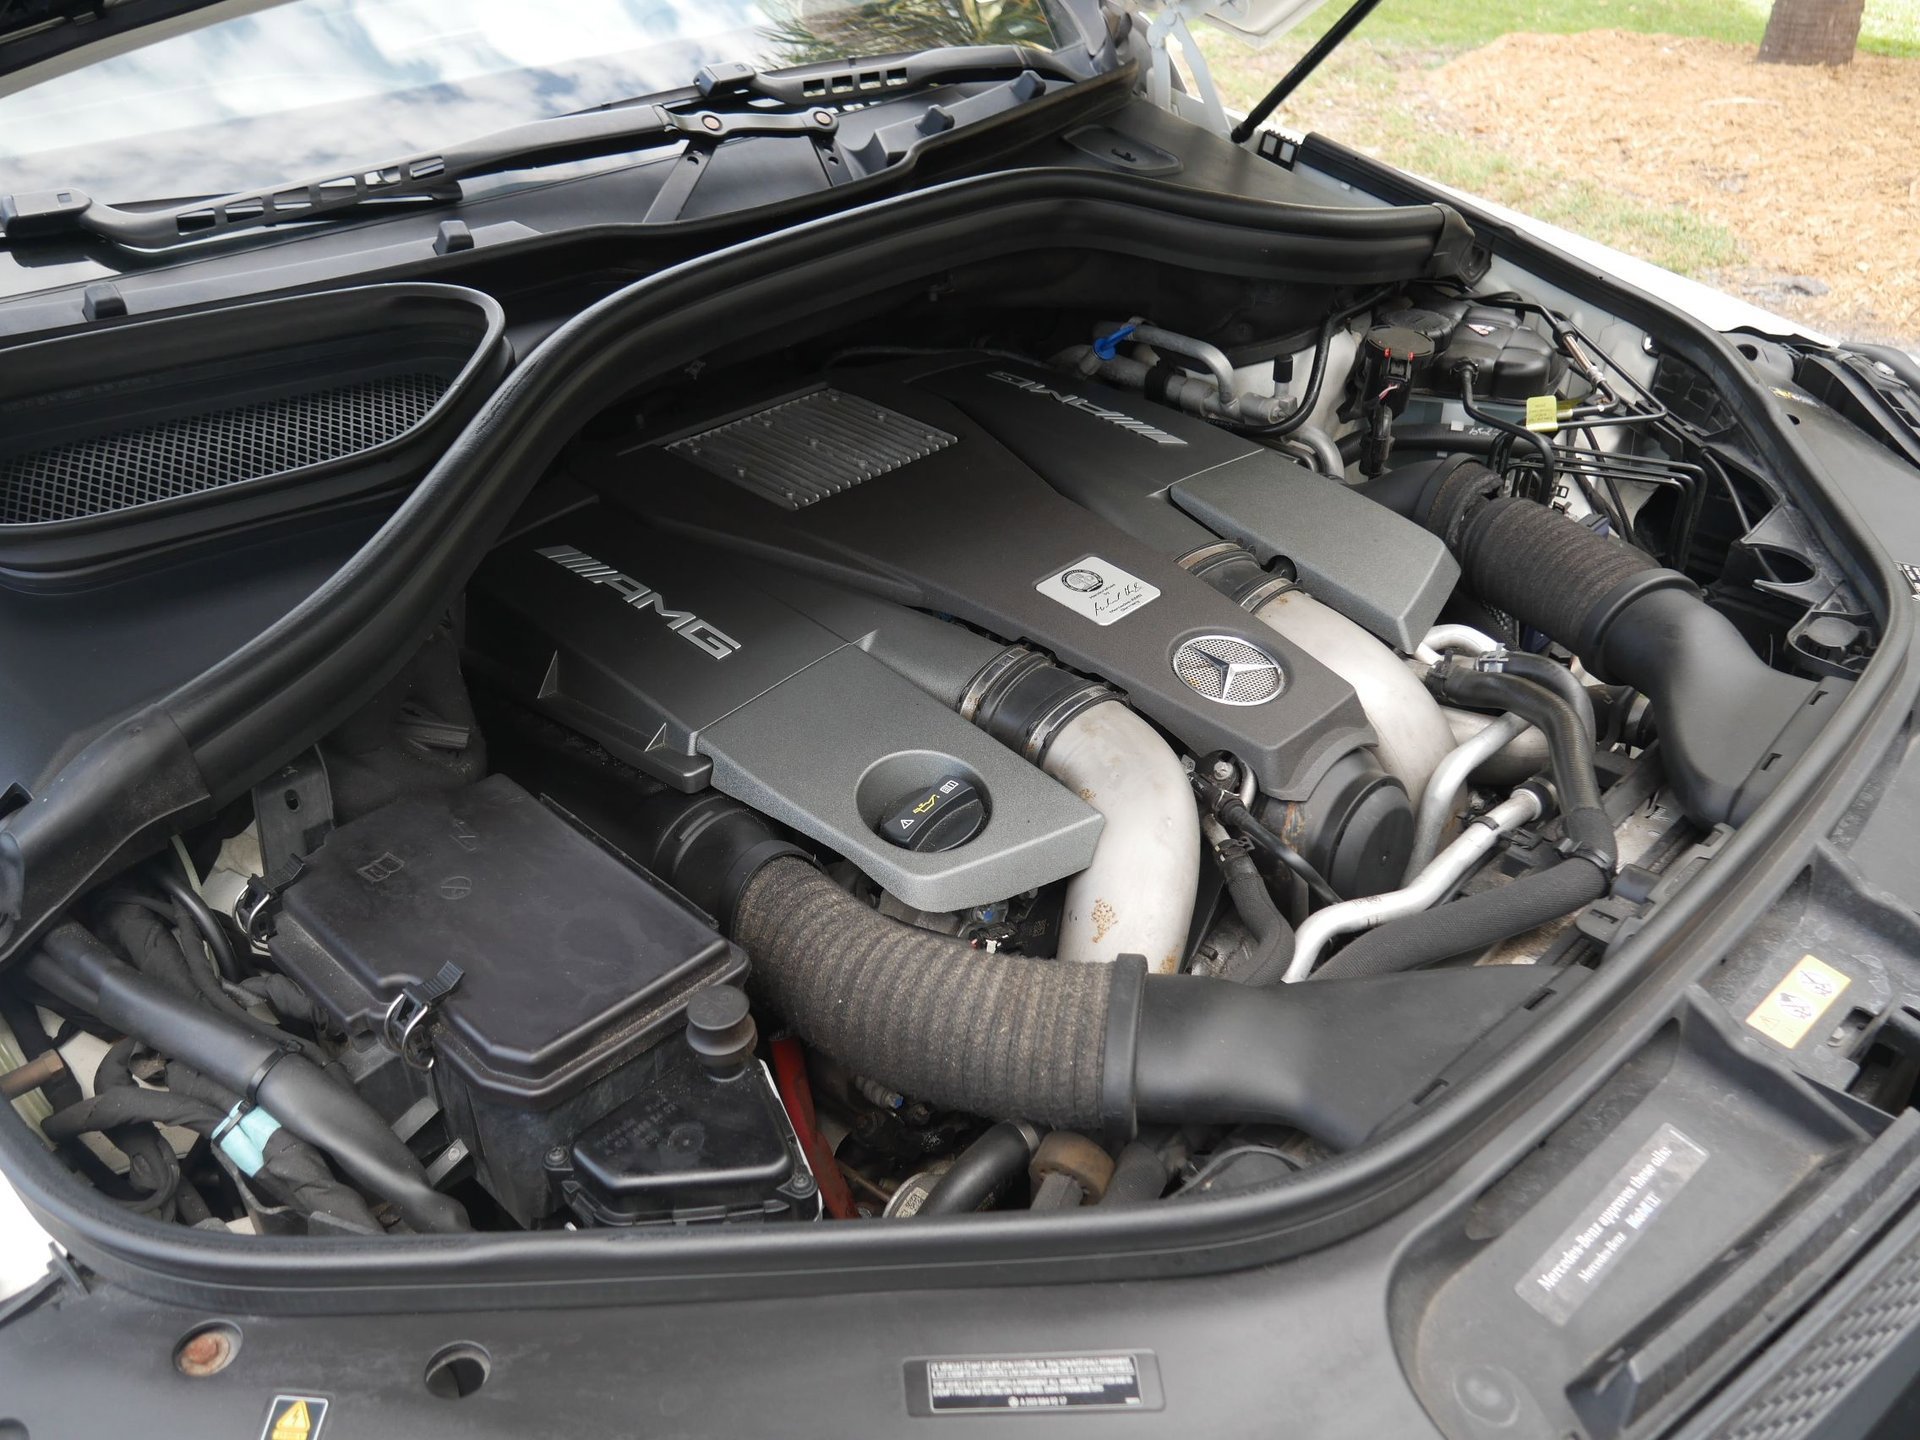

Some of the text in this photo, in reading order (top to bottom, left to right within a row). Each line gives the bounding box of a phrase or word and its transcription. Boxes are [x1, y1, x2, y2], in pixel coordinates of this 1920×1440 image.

[580, 569, 742, 660] AMG
[1537, 1221, 1605, 1292] Mercedes-Benz
[1597, 1185, 1637, 1226] approves
[1629, 1163, 1657, 1189] these
